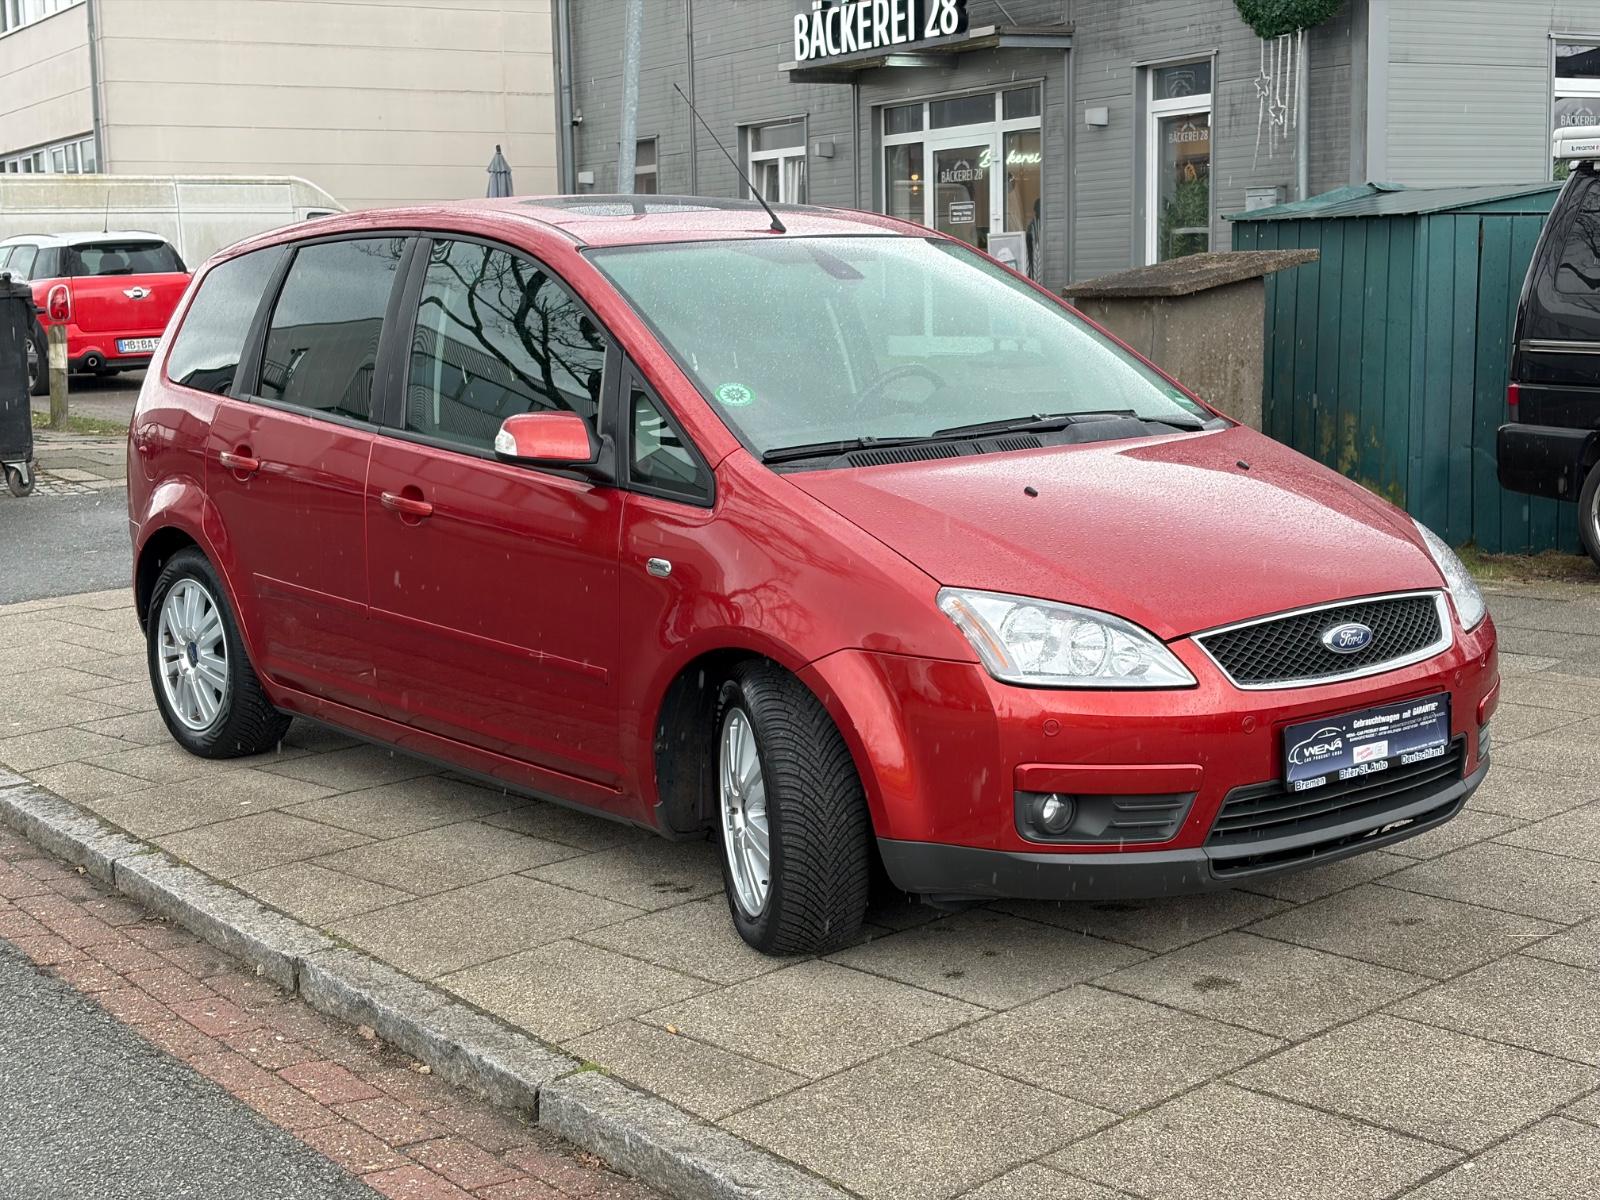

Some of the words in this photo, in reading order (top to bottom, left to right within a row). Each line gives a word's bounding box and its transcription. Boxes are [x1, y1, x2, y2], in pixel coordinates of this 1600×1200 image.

[794, 0, 915, 61] BÄCKEREI
[924, 0, 960, 38] 28
[1168, 130, 1199, 144] BÄCKEREI
[1200, 129, 1209, 141] 28
[941, 169, 974, 183] BÄCKEREI
[974, 168, 983, 180] 28
[124, 340, 136, 350] HB
[141, 339, 153, 349] BA
[1339, 629, 1364, 647] Ford
[1353, 713, 1400, 729] Gebrauchtwagen
[1295, 776, 1326, 791] Bremen
[1401, 745, 1445, 765] Deutschland
